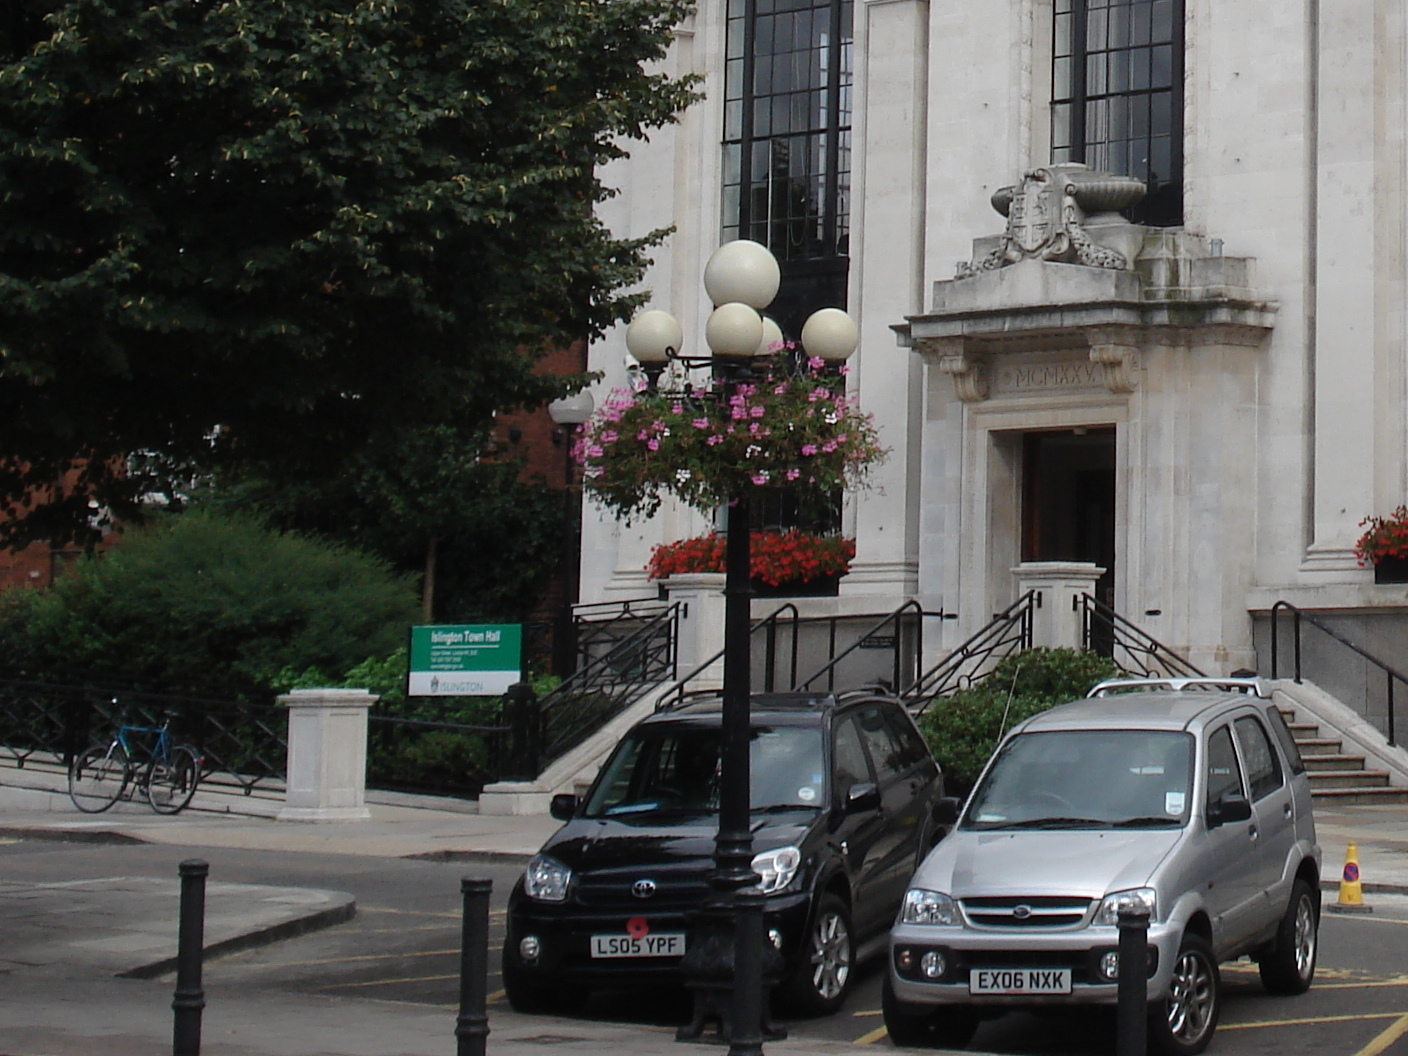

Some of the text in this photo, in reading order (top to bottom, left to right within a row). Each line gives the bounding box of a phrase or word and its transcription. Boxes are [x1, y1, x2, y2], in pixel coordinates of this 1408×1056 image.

[431, 630, 501, 646] Islington Town Hall
[441, 681, 484, 692] ISLINGTON
[597, 937, 678, 955] LS05 YPF
[978, 971, 1064, 990] EX06 NXK
